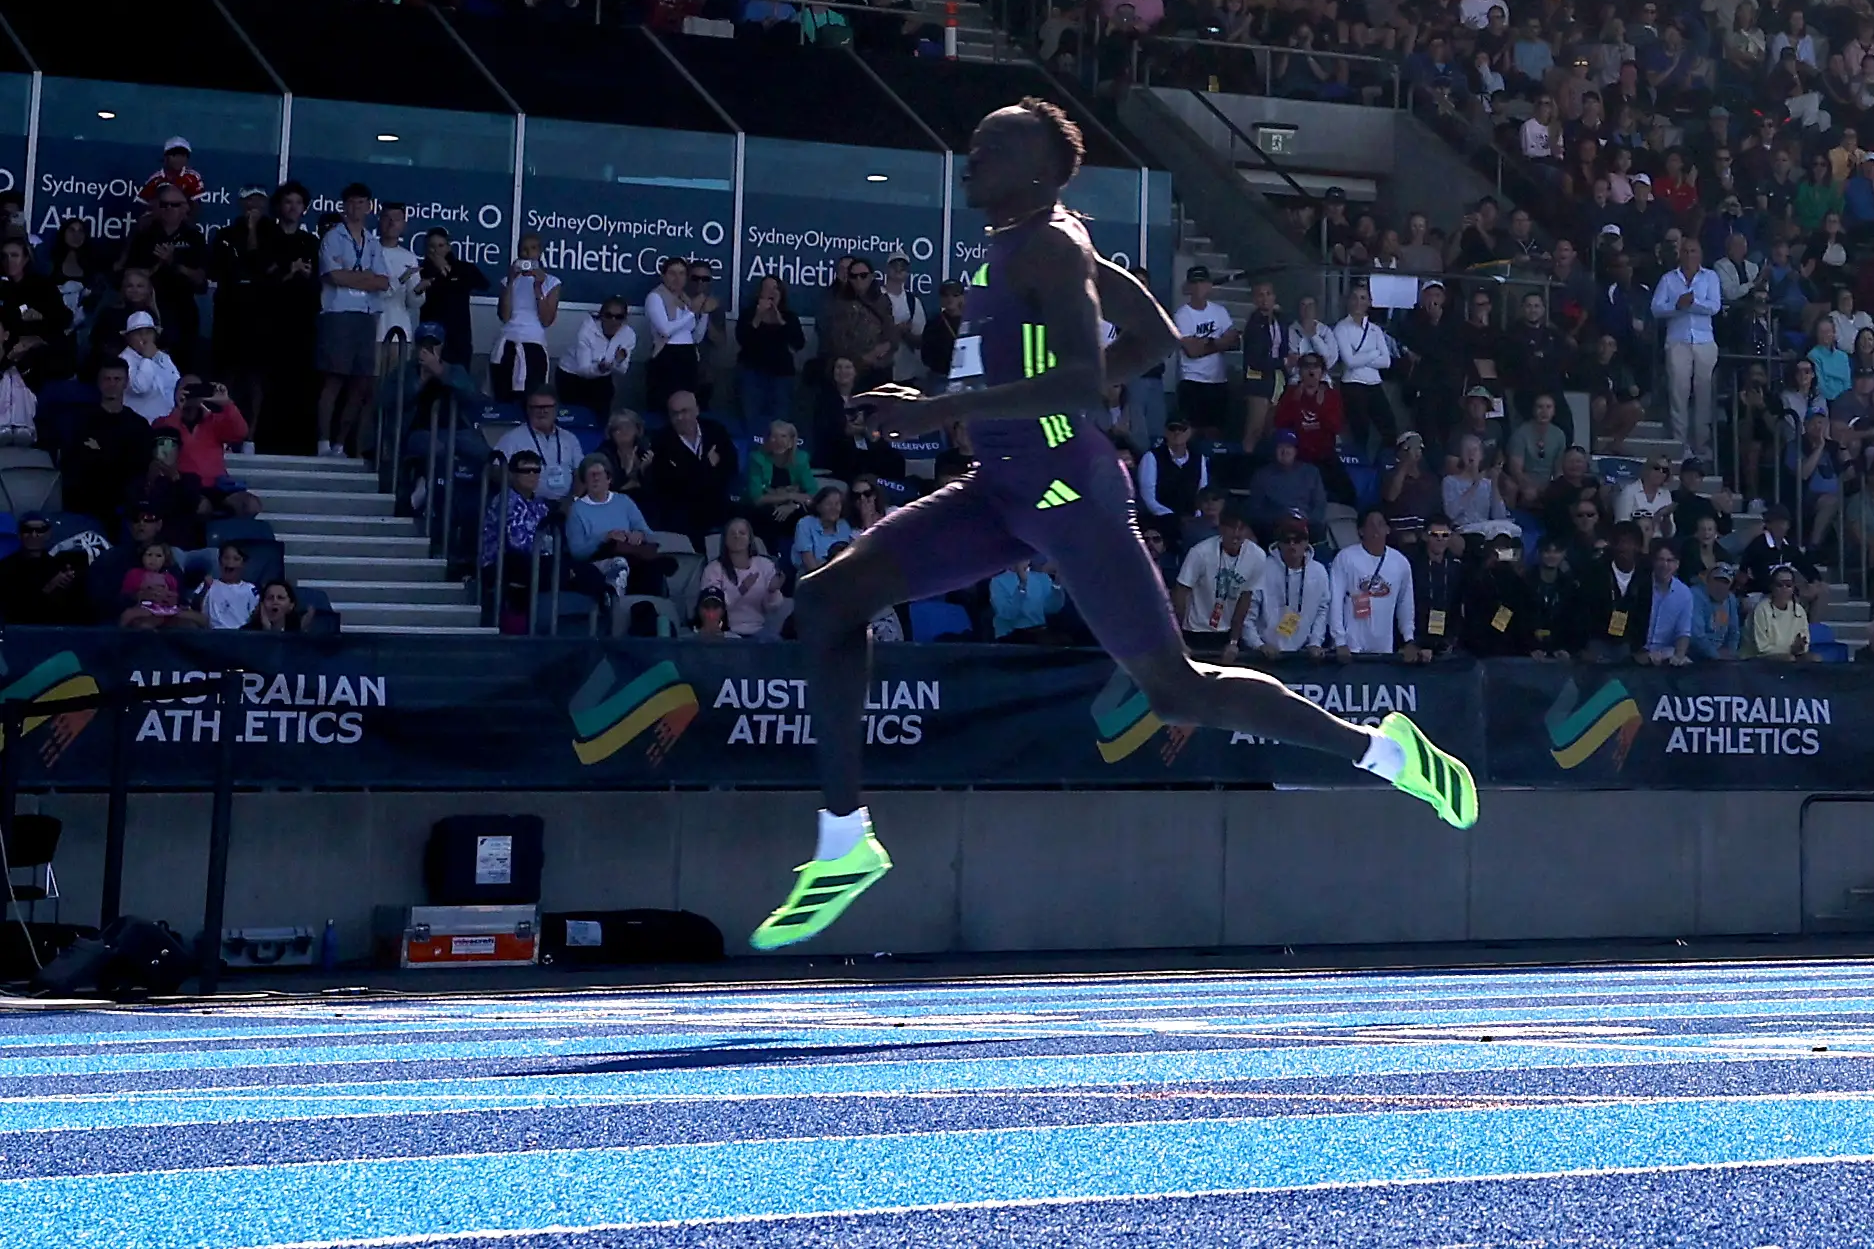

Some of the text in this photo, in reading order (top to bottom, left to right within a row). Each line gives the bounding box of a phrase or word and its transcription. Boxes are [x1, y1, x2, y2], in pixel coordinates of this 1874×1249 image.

[41, 173, 231, 205] SydneyOlyark
[38, 205, 138, 240] Athlet
[527, 209, 694, 239] SydneyOlympicPark
[409, 230, 500, 265] Cntre
[748, 225, 905, 254] SydneyOlympicPark
[637, 247, 723, 281] Cete
[746, 254, 838, 288] Athleti
[712, 678, 941, 711] AUSTLIAN
[1651, 694, 1833, 726] AUSTRALIAN
[135, 708, 364, 745] ATHETICS
[726, 713, 924, 746] ATHLICS
[1664, 726, 1821, 756] ATHLETICS
